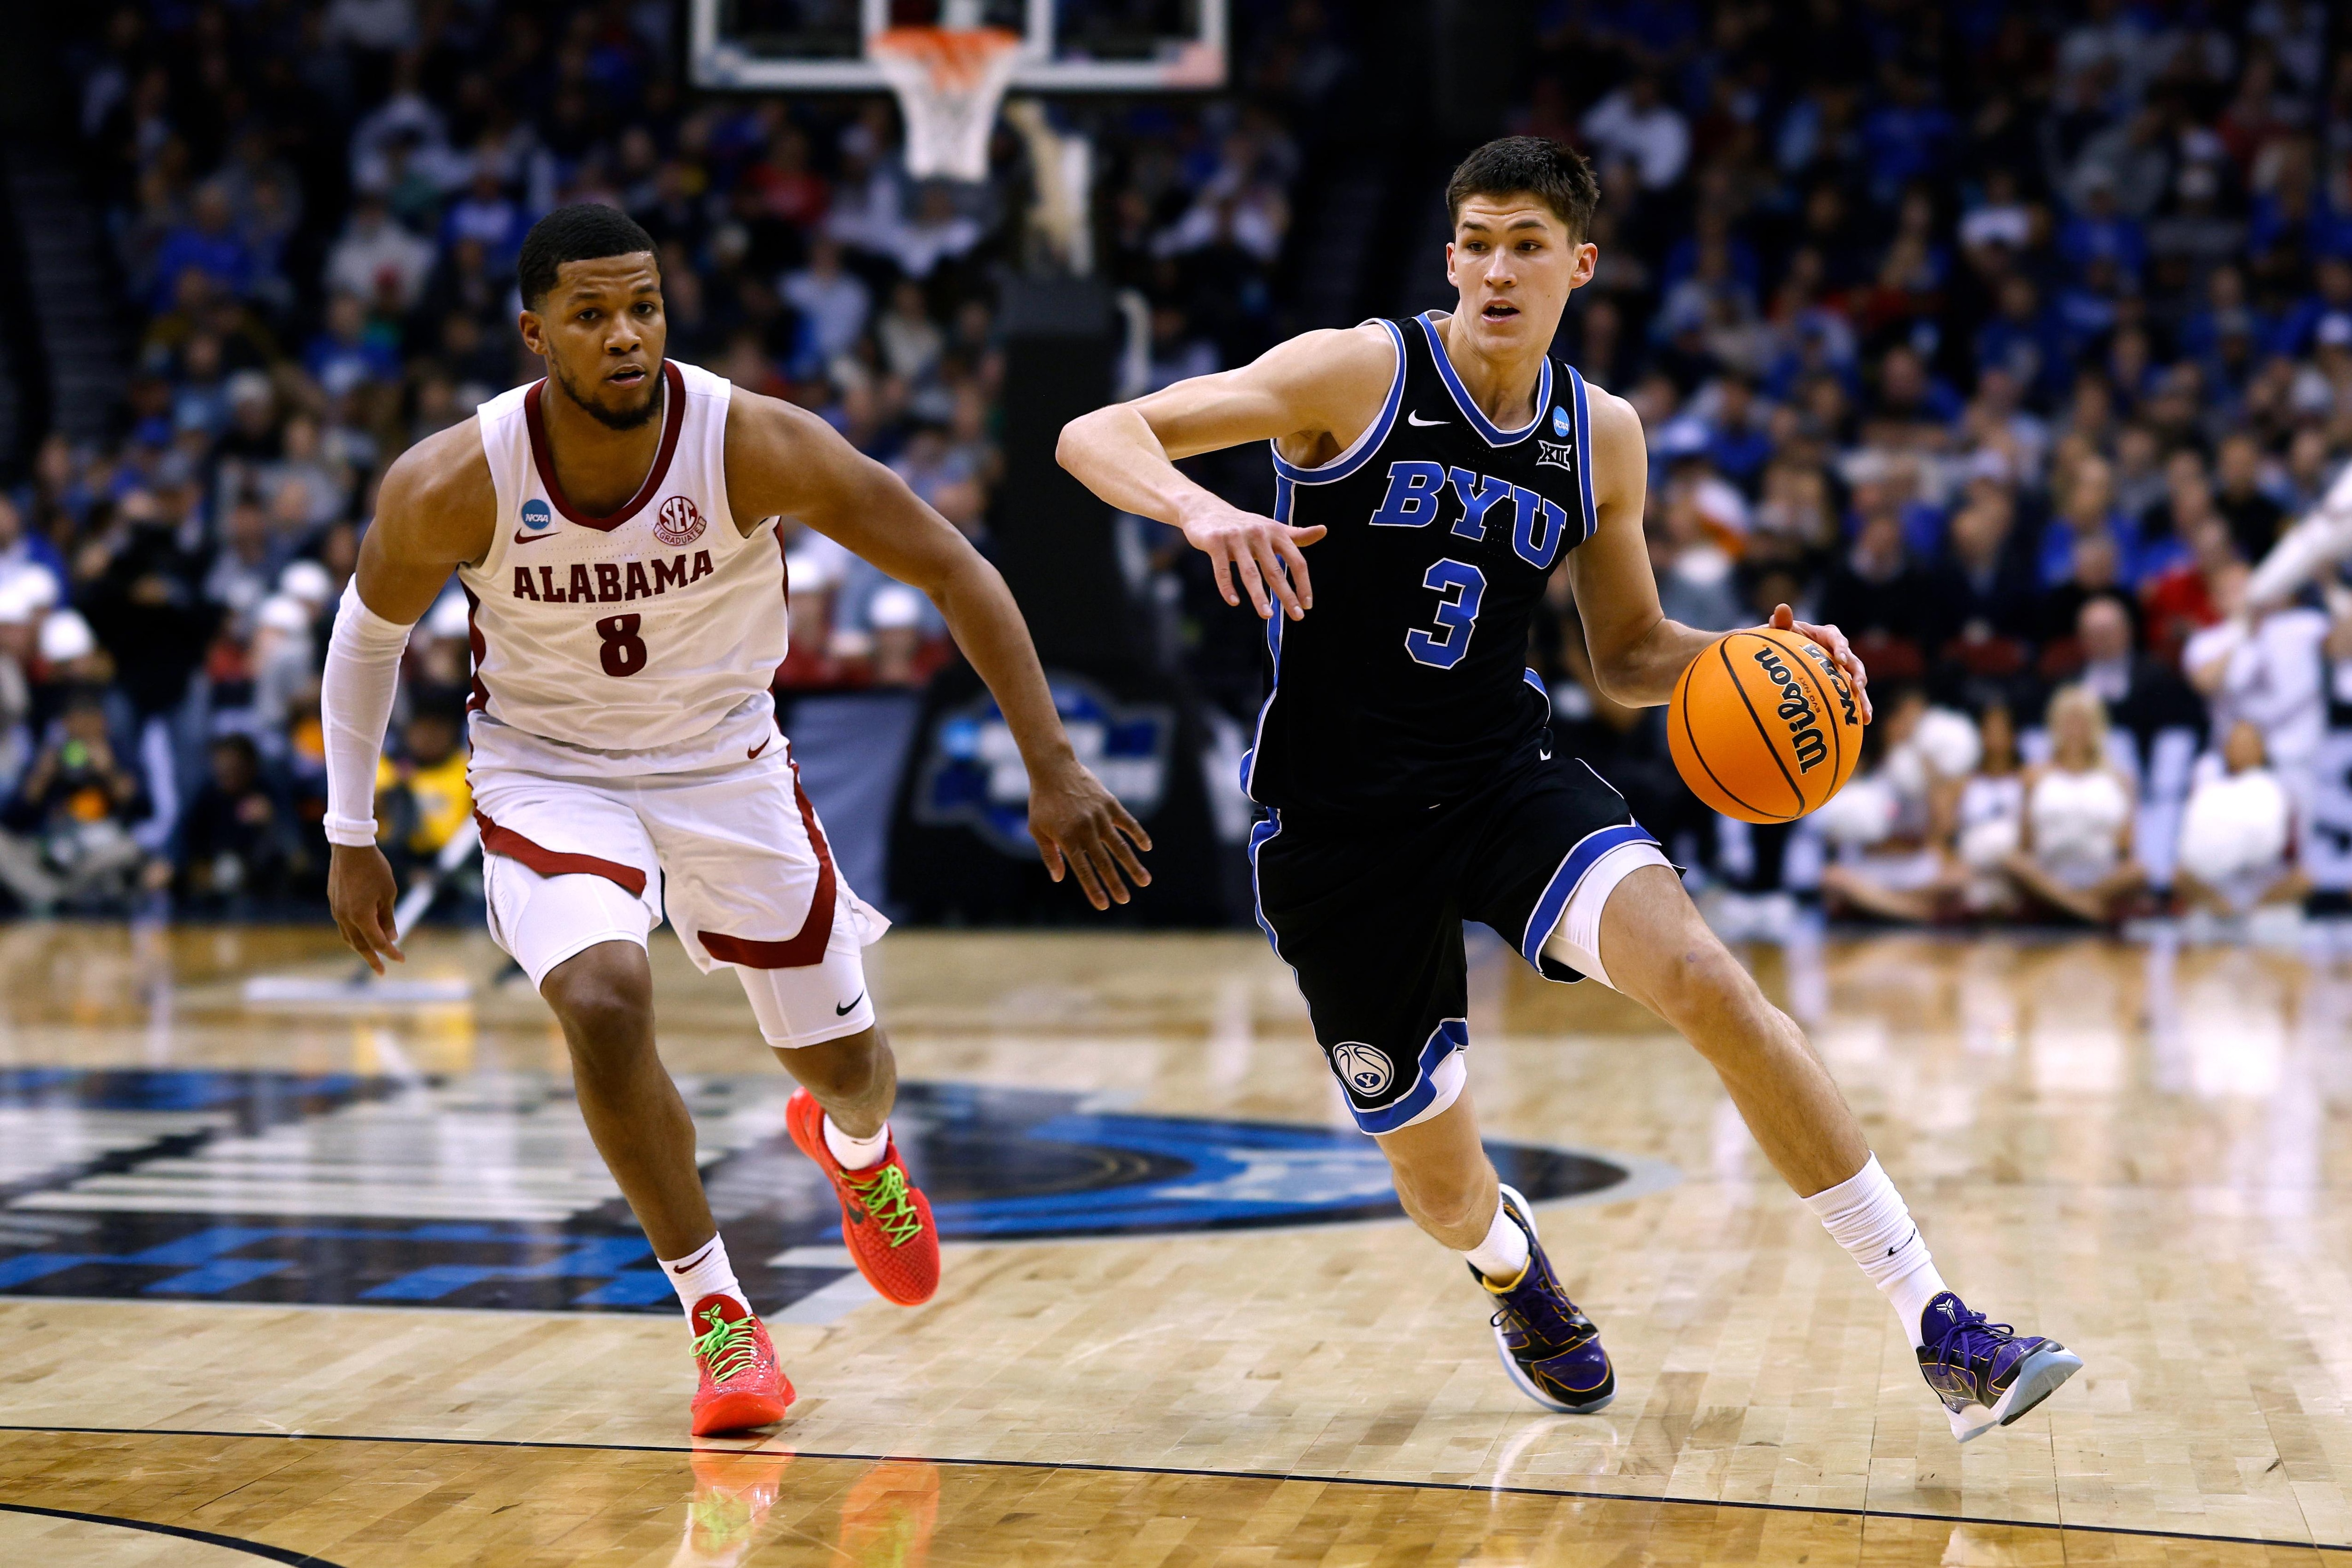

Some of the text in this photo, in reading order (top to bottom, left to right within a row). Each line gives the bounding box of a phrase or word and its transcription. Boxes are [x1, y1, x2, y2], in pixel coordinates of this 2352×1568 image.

[1555, 418, 1569, 431] NCAA
[525, 513, 549, 523] NCAA
[660, 497, 696, 532] SEC
[660, 527, 702, 544] GRADUATE
[1369, 460, 1567, 570] BYU
[513, 549, 714, 603] ALABAMA
[1405, 557, 1487, 670] 3
[596, 613, 647, 677] 8
[1798, 676, 1821, 713] EVO NXT
[1802, 643, 1858, 726] NCAA
[1754, 647, 1828, 775] Wilson
[1357, 1074, 1374, 1087] Y
